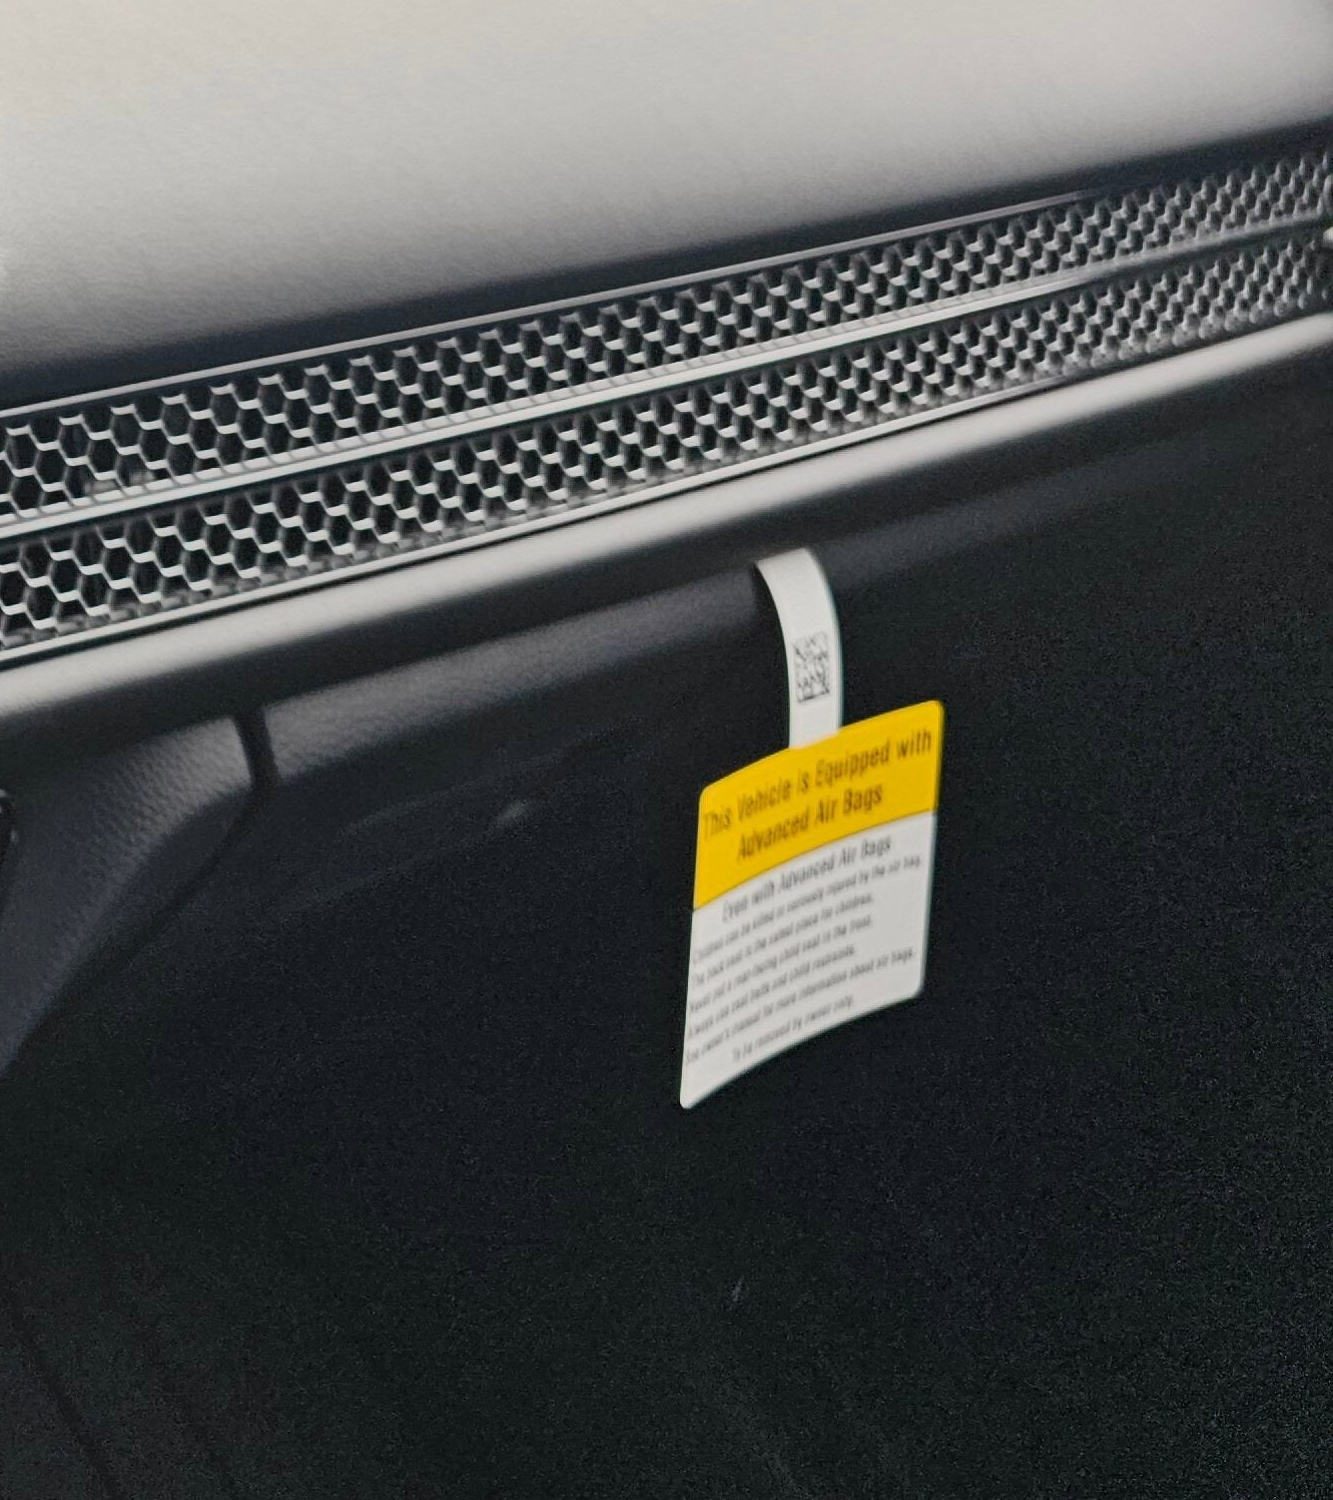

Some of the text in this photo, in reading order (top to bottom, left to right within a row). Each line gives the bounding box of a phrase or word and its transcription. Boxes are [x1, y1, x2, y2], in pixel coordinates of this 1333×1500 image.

[797, 768, 810, 793] is
[815, 739, 890, 788] Equipped
[896, 728, 932, 757] with
[737, 784, 884, 861] Advanced Air Bags
